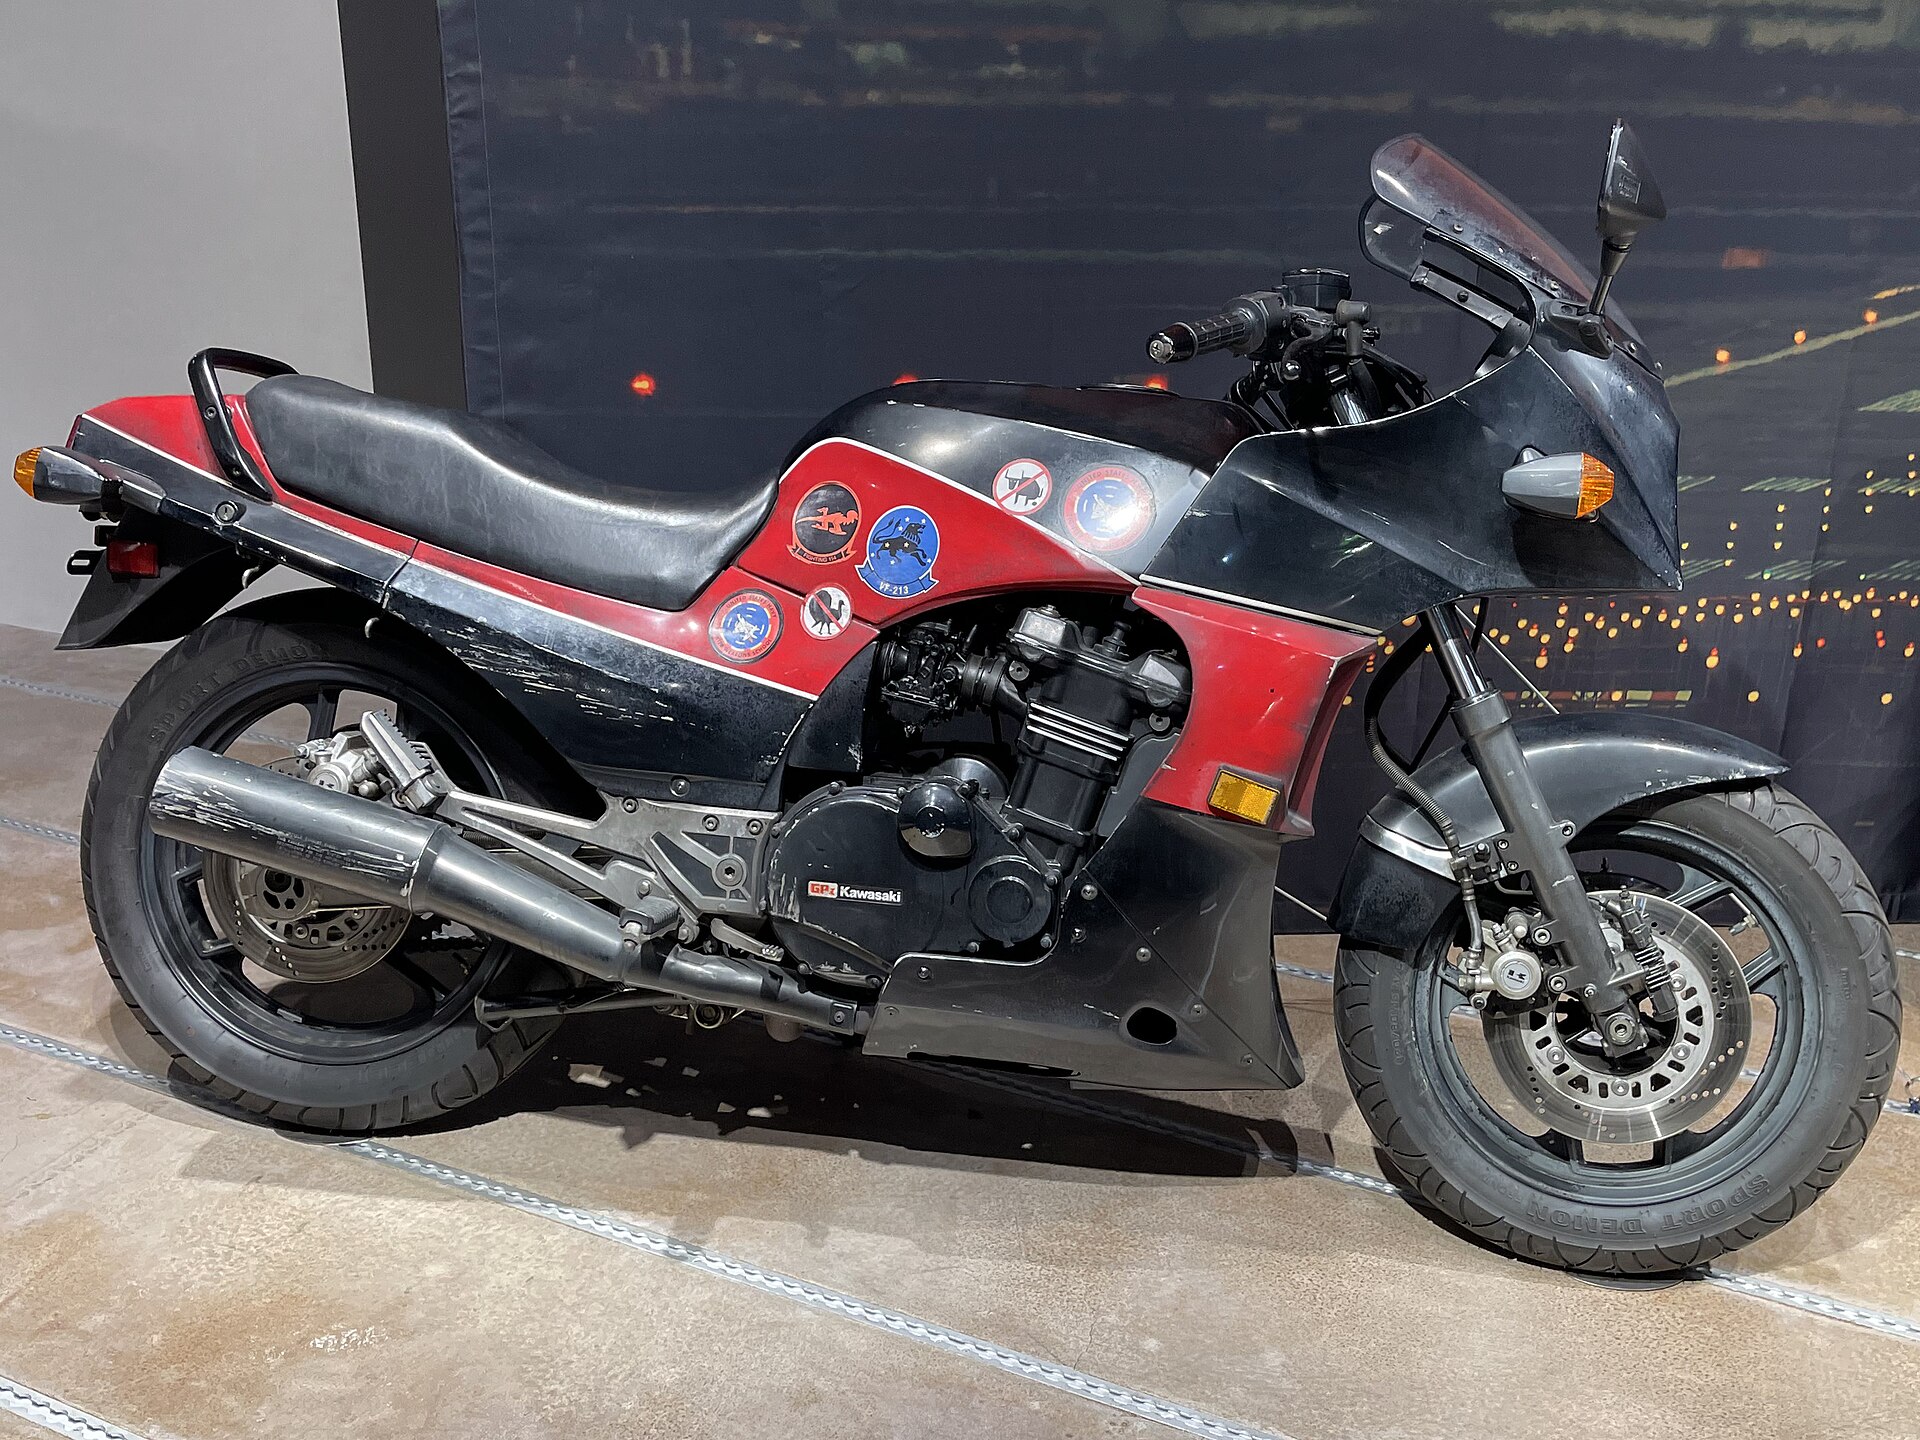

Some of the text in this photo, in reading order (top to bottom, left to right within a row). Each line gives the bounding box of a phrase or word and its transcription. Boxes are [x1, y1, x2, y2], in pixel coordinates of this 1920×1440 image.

[880, 582, 909, 595] VF-213
[840, 885, 901, 903] Kawasaki
[1526, 1172, 1770, 1235] SPORT DEMON
